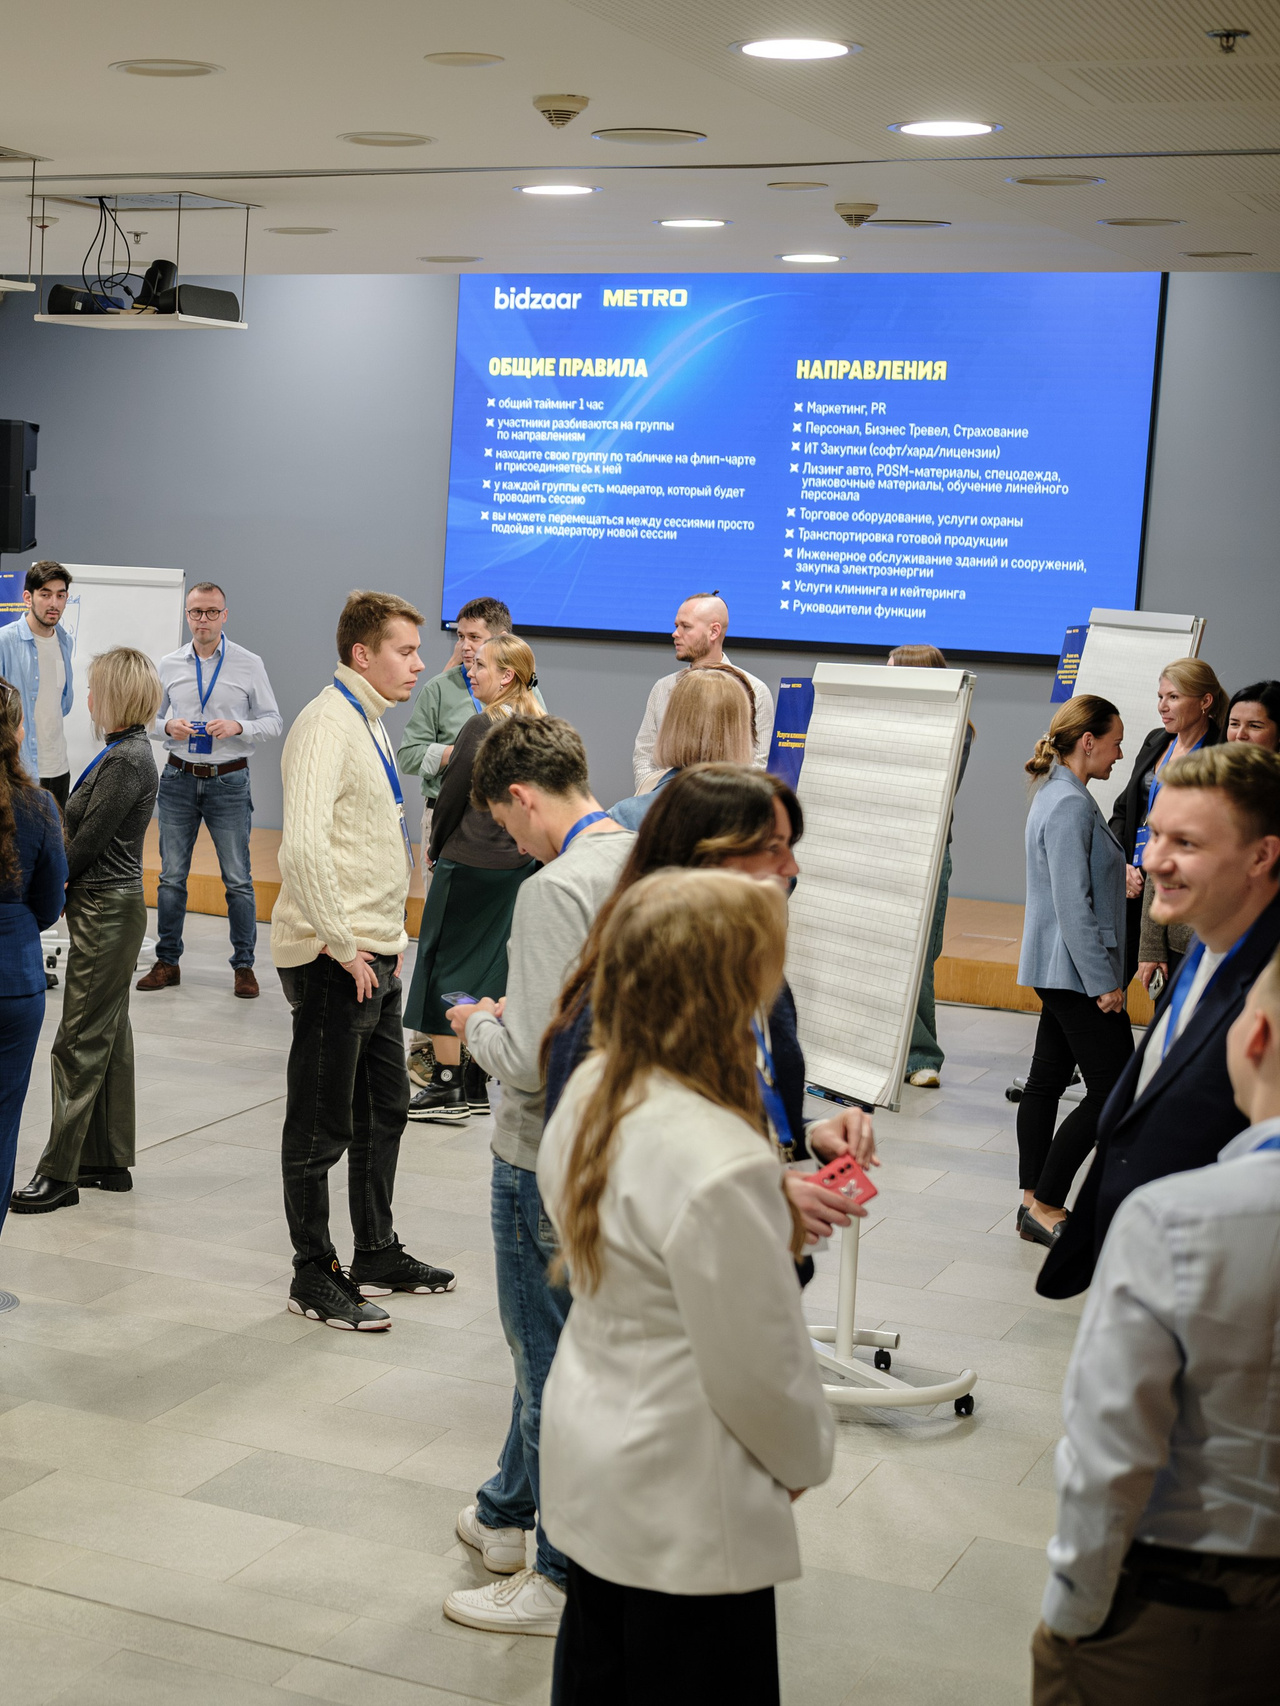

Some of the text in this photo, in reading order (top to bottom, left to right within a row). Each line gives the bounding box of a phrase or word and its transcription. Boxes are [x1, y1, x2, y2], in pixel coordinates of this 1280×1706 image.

[495, 287, 687, 309] bidzaar METRO
[489, 358, 648, 377] ОБЩИЕ ПРАВИЛА
[797, 360, 947, 380] НАПРАВЛЕНИЯ
[499, 398, 604, 410] общий тайминг 1 час
[807, 402, 886, 415] Маркетинг, PR
[498, 418, 674, 432] участники разбиваются на группы
[806, 422, 1028, 438] Персонал, Бизнес Тревел, Страхование
[497, 430, 585, 442] по направлениям
[496, 450, 756, 466] находите свою группу по табличке на флип-чарте
[805, 443, 1000, 459] ИТ Закупки (софт/хард/лицензии)
[496, 462, 622, 474] и присоединяетесь к ней
[802, 463, 1061, 482] Лизинг авто, POSM-материалы, спецодежда,
[494, 480, 745, 498] у каждой группы есть модератор, который будет
[802, 478, 1069, 495] упаковочные материалы, обучение линейного
[494, 492, 586, 504] проводить сессию
[801, 490, 859, 502] персонала
[492, 512, 754, 530] вы можете перемещаться между сессиями просто
[800, 507, 1023, 528] Торговое оборудование, услуги охраны
[492, 523, 677, 540] подойдя к модератору новой сессии
[798, 528, 1007, 547] Транспортировка готовой продукции
[797, 547, 1087, 572] Инженерное обслуживание зданий и сооружений,
[796, 563, 934, 578] закупка электроэнергии
[794, 580, 965, 600] Услуги клининга и кейтеринга
[793, 600, 926, 619] Руководители функции
